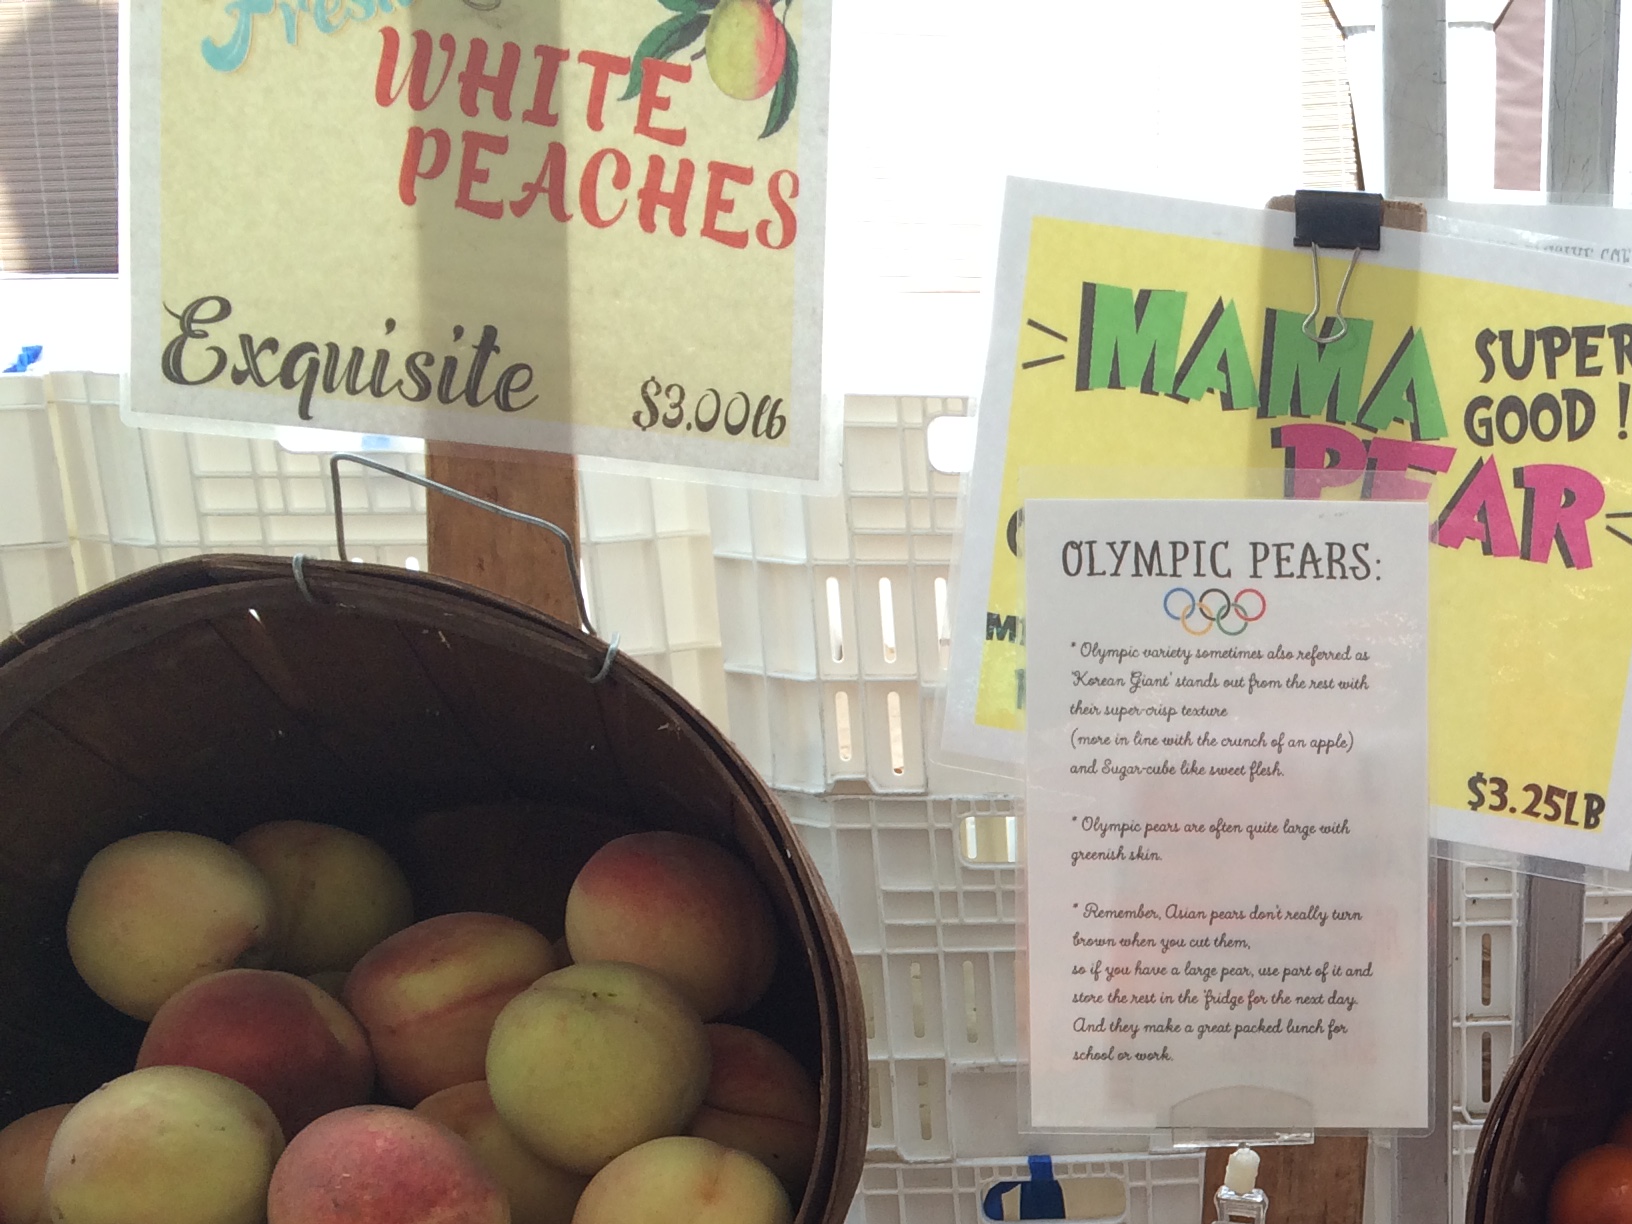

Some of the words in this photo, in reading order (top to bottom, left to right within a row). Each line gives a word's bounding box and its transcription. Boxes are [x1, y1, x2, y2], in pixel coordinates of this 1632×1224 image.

[375, 26, 695, 146] WHITE
[399, 127, 800, 250] PEACHES
[161, 295, 540, 420] Exquisite
[1076, 281, 1448, 440] MAMA
[631, 376, 786, 440] $3.00lb
[1464, 388, 1595, 446] GOOD
[1271, 423, 1606, 570] PEAR
[1062, 540, 1231, 578] OLYMPIC
[1249, 542, 1381, 581] PEARS:
[1080, 641, 1140, 664] Olympic
[1142, 646, 1192, 665] variety
[1195, 646, 1263, 660] sometimes
[1267, 644, 1294, 660] also
[1296, 644, 1352, 666] referred
[1355, 653, 1370, 661] as
[1175, 672, 1220, 688] stands
[1223, 677, 1245, 689] out
[1248, 673, 1282, 695] from
[1286, 673, 1306, 689] the
[1308, 678, 1335, 690] rest
[1338, 674, 1369, 690] with
[1070, 699, 1101, 715] their
[1104, 704, 1178, 722] super-crisp
[1181, 705, 1228, 717] texture
[1071, 728, 1111, 749] (more
[1115, 733, 1129, 745] in
[1133, 730, 1159, 746] line
[1162, 731, 1193, 746] with
[1197, 731, 1218, 747] the
[1221, 732, 1267, 748] crunch
[1271, 732, 1285, 754] of
[1288, 738, 1306, 748] an
[1310, 731, 1354, 754] apple)
[1070, 758, 1098, 774] and
[1102, 758, 1176, 781] Sugar-cube
[1180, 760, 1206, 775] like
[1209, 765, 1246, 776] sweet
[1249, 760, 1284, 783] flesh.
[1467, 772, 1606, 829] $3.25LB
[1081, 815, 1141, 838] Olympic
[1143, 821, 1180, 838] pears
[1184, 823, 1206, 833] are
[1209, 817, 1242, 839] often
[1246, 820, 1279, 840] quite
[1283, 818, 1316, 840] large
[1319, 819, 1350, 835] with
[1071, 845, 1126, 866] greenish
[1129, 846, 1163, 862] skin.
[1083, 902, 1161, 920] Remember,
[1165, 904, 1207, 920] Asian
[1209, 909, 1246, 926] pears
[1249, 904, 1283, 921] don't
[1284, 905, 1328, 927] really
[1332, 908, 1362, 921] turn
[1072, 931, 1116, 947] brown
[1119, 931, 1157, 947] when
[1160, 938, 1186, 954] you
[1189, 937, 1210, 948] cut
[1213, 932, 1251, 950] them,
[1072, 965, 1086, 976] so
[1090, 959, 1102, 981] if
[1105, 967, 1131, 982] you
[1134, 959, 1168, 976] have
[1171, 967, 1180, 976] a
[1184, 960, 1218, 982] large
[1220, 966, 1254, 983] pear,
[1258, 967, 1280, 977] use
[1282, 964, 1312, 983] part
[1315, 961, 1330, 983] of
[1332, 964, 1343, 977] it
[1345, 961, 1373, 977] and
[1072, 993, 1103, 1004] store
[1107, 988, 1129, 1004] the
[1130, 993, 1157, 1004] rest
[1160, 991, 1175, 1004] in
[1178, 988, 1199, 1004] the
[1247, 989, 1268, 1011] for
[1271, 989, 1292, 1004] the
[1295, 993, 1324, 1005] next
[1327, 989, 1358, 1011] day.
[1073, 1017, 1106, 1033] And
[1110, 1017, 1140, 1039] they
[1144, 1017, 1182, 1033] make
[1184, 1024, 1194, 1033] a
[1197, 1022, 1232, 1040] great
[1233, 1018, 1283, 1039] packed
[1286, 1018, 1325, 1034] lunch
[1327, 1018, 1348, 1040] for
[1072, 1046, 1115, 1061] school
[1117, 1053, 1132, 1061] or
[1135, 1046, 1174, 1061] work.
